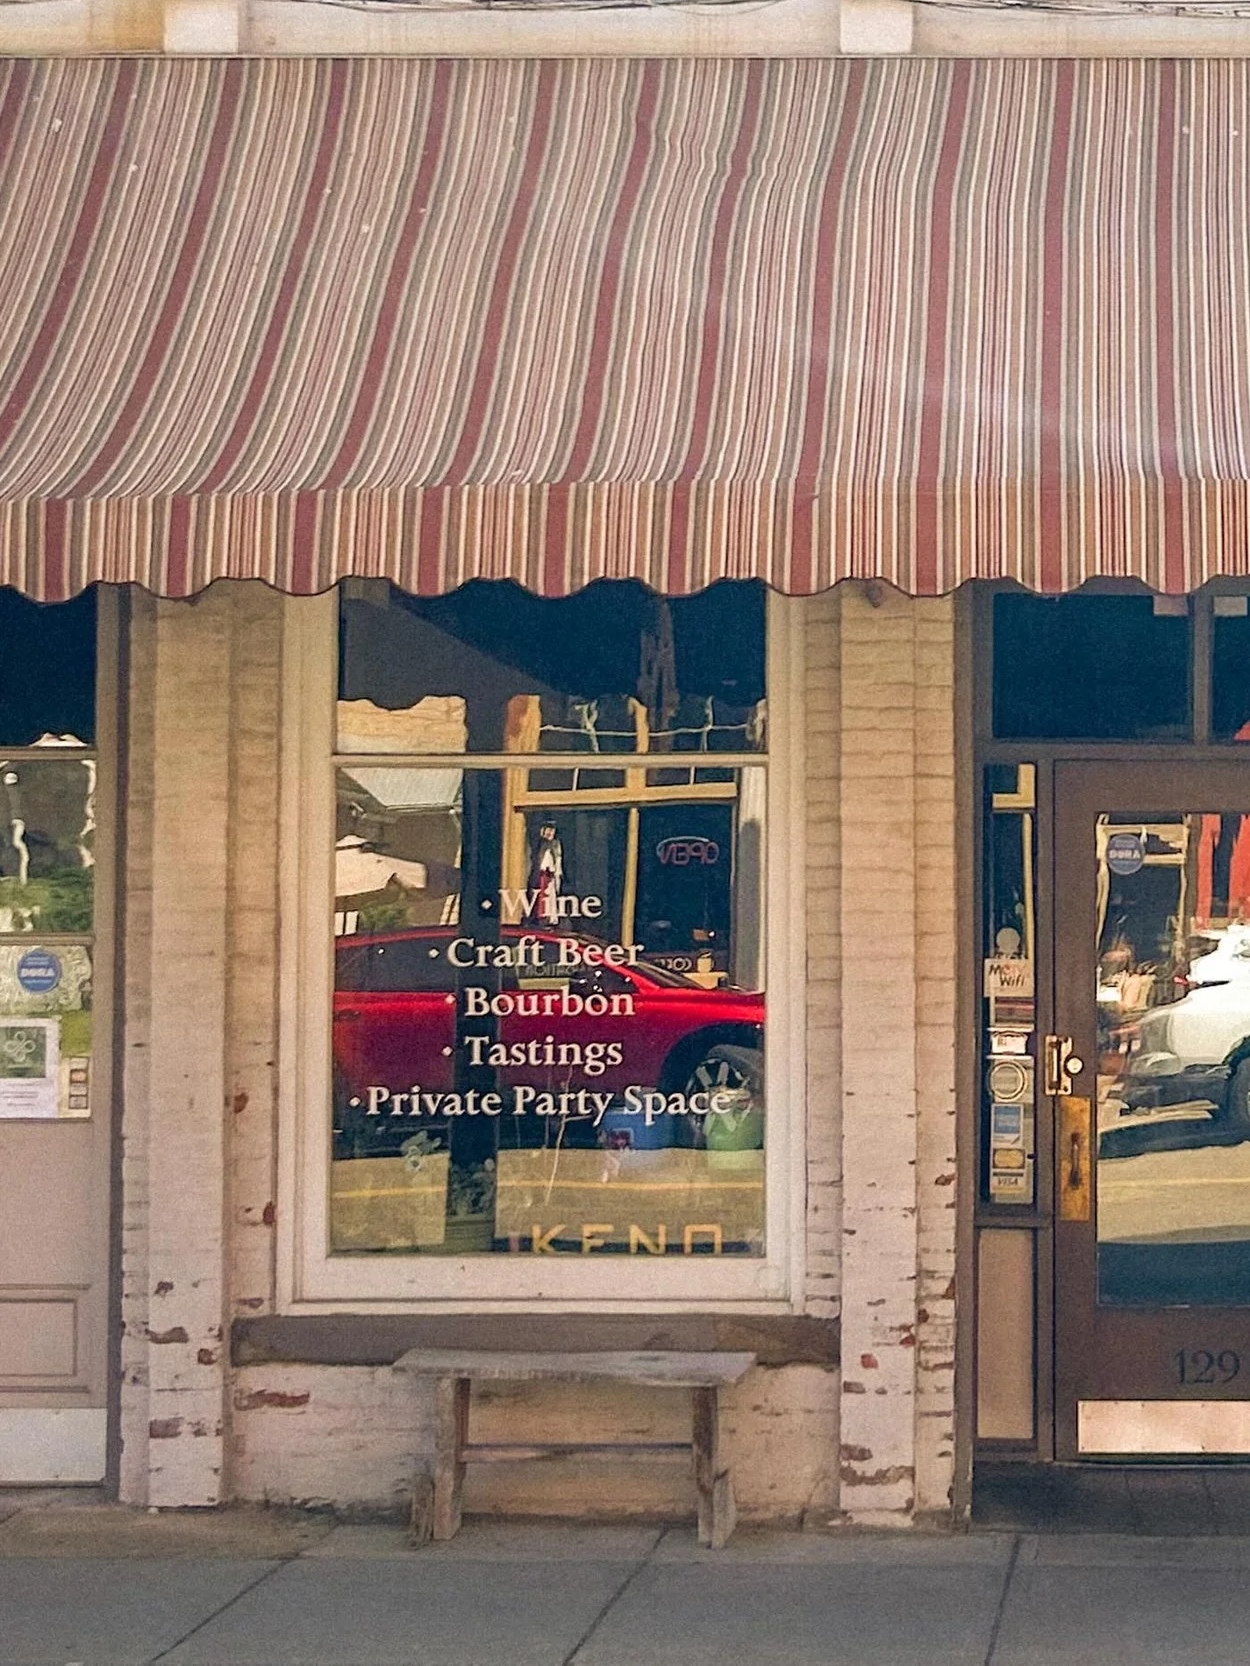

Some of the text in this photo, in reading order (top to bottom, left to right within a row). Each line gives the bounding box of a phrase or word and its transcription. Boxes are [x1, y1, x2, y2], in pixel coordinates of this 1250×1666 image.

[497, 889, 602, 919] Wine
[446, 935, 546, 969] Craft
[558, 938, 646, 968] Beer
[464, 986, 636, 1018] Bourbon
[465, 1036, 624, 1075] Tastings
[366, 1084, 732, 1127] Private Party Space
[1174, 1349, 1240, 1383] 129
